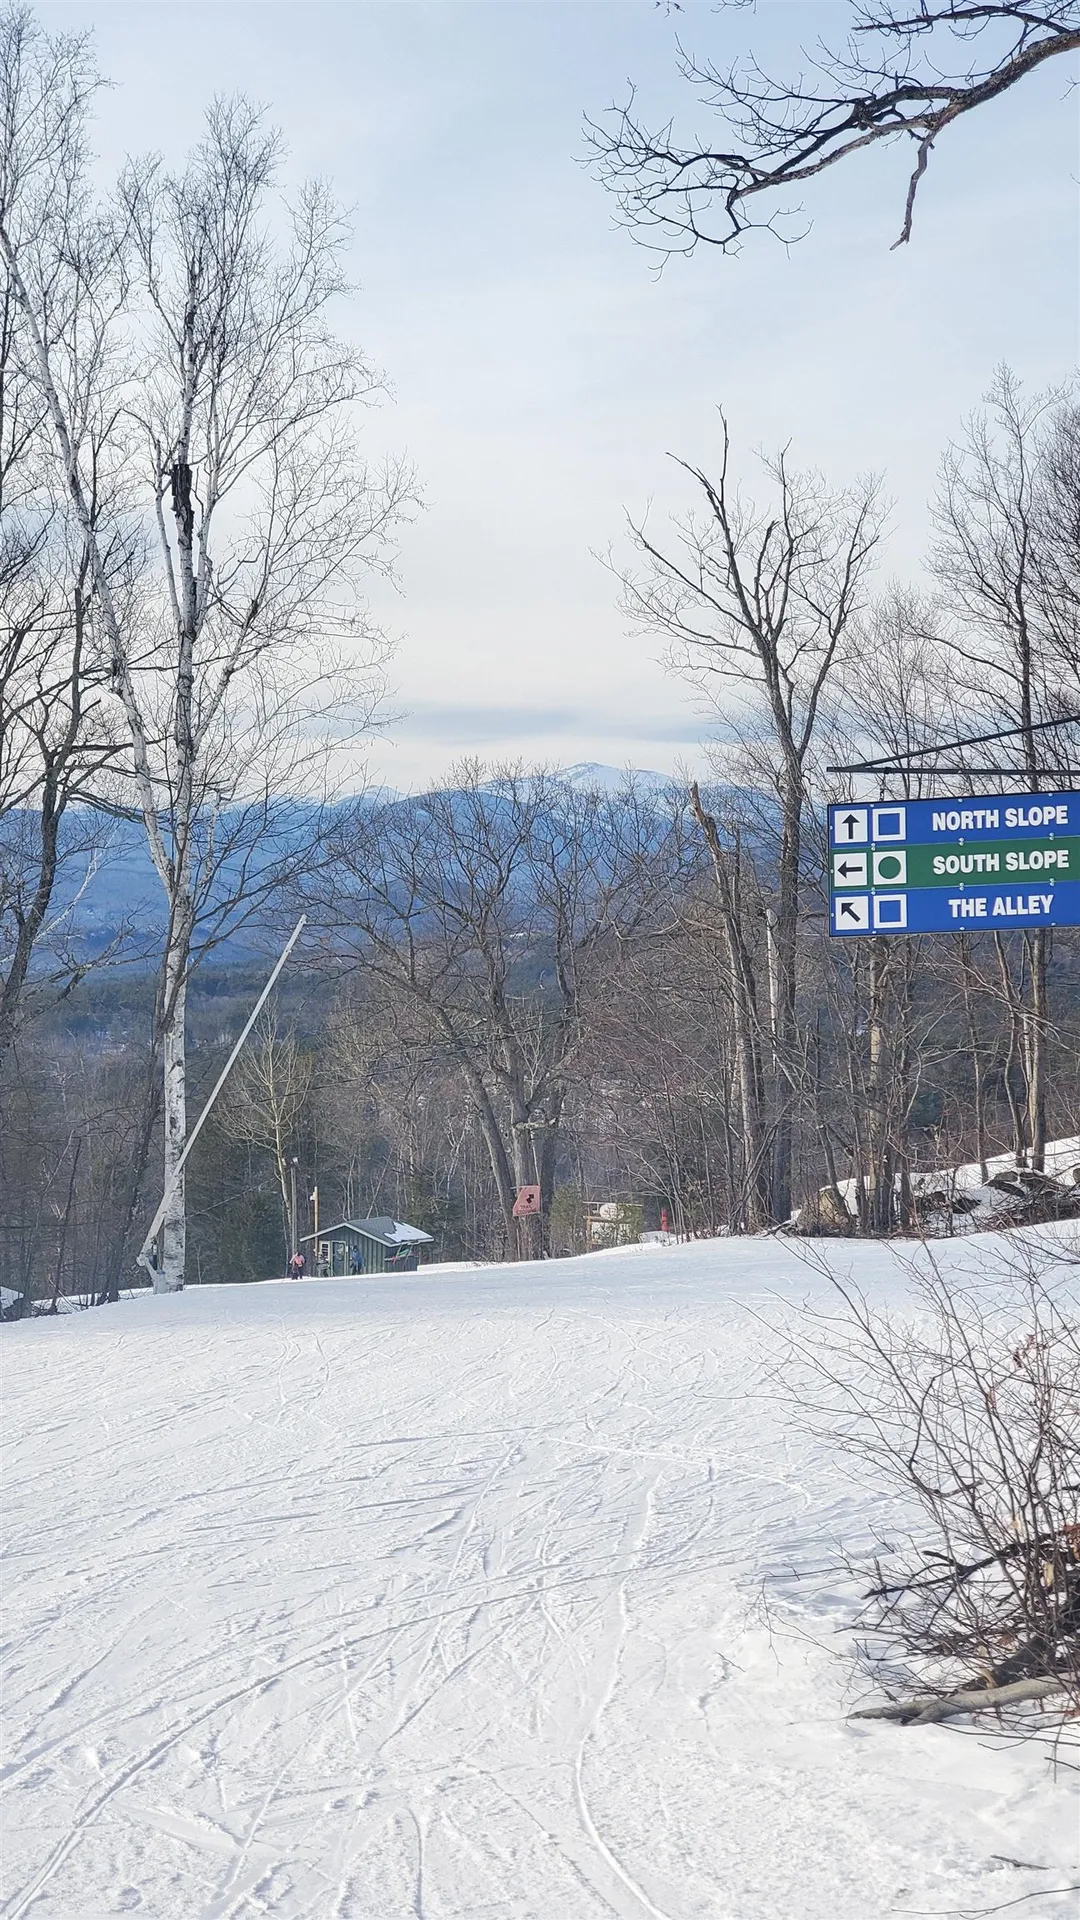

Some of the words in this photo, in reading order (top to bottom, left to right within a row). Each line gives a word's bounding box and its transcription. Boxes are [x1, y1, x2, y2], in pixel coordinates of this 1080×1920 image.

[932, 810, 999, 831] NORTH
[1005, 805, 1068, 828] SLOPE
[933, 853, 1000, 875] SOUTH
[1005, 850, 1070, 871] SLOPE
[949, 898, 988, 918] THE
[992, 895, 1054, 916] ALLEY
